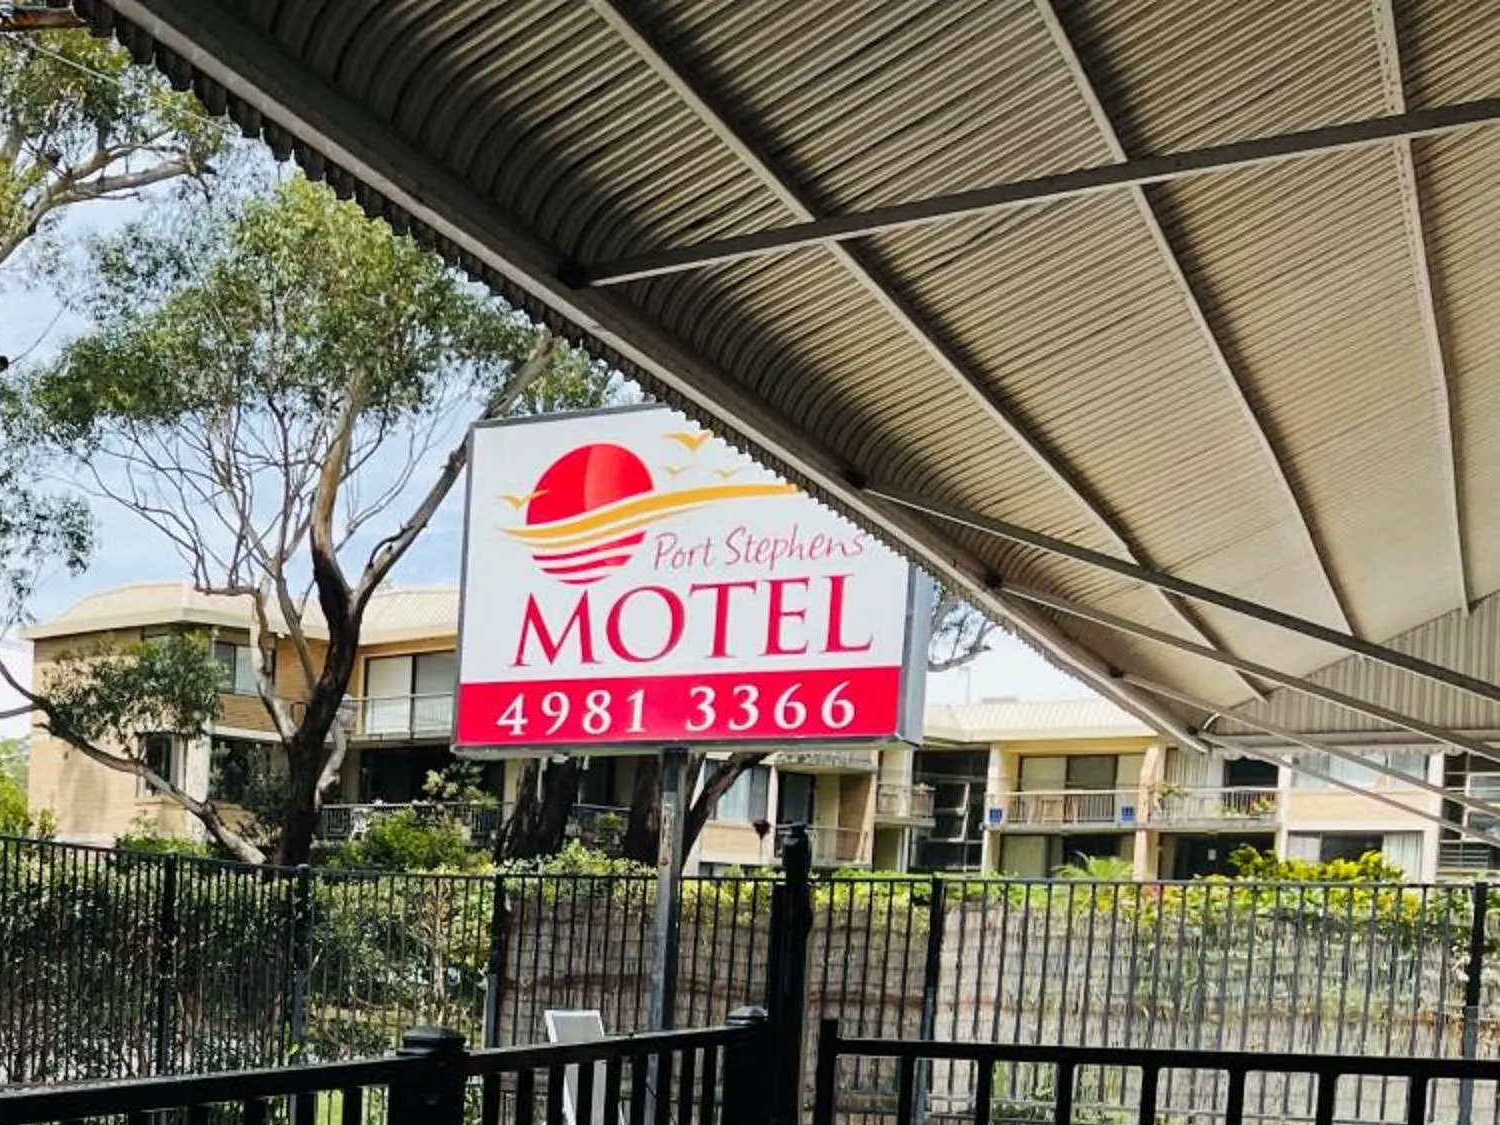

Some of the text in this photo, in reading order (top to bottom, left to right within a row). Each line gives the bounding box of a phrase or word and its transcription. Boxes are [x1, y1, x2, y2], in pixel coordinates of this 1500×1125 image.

[654, 523, 864, 571] Port Stephens
[512, 574, 874, 668] MOTEL
[496, 681, 856, 736] 4981 3366
